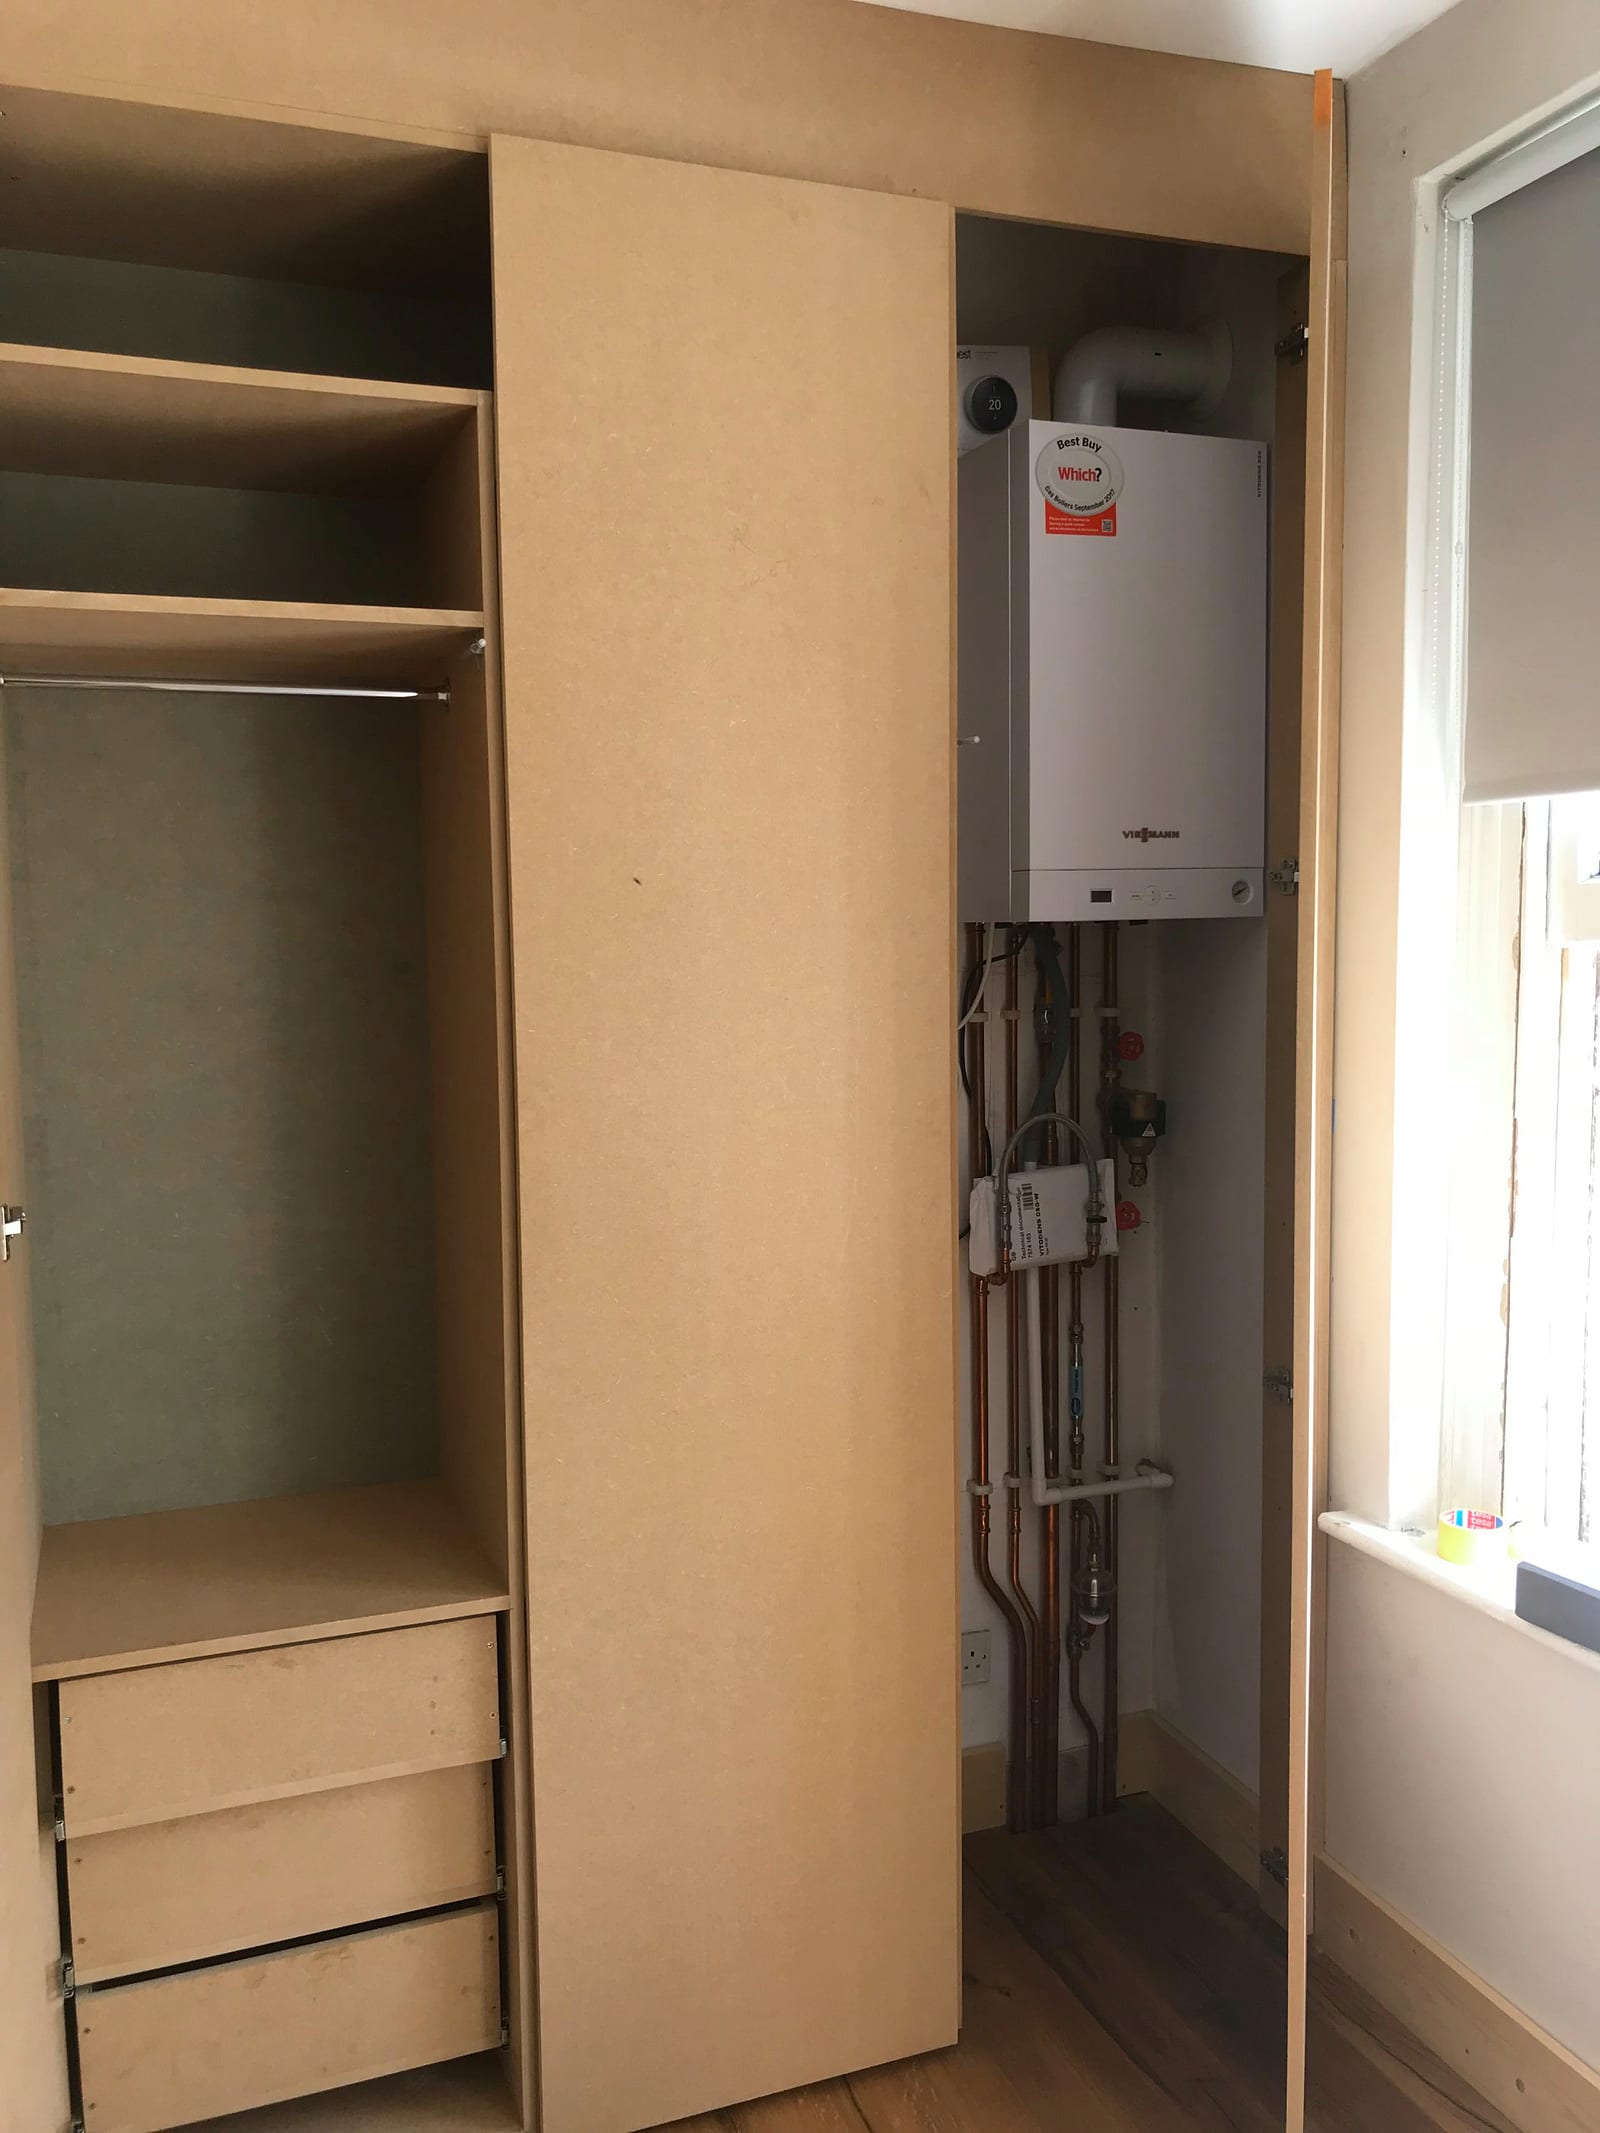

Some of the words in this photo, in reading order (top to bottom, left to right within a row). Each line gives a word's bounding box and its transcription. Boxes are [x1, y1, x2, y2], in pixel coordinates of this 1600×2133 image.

[988, 399, 1002, 411] 20
[1056, 436, 1081, 450] Best
[1081, 437, 1102, 453] Buy
[1058, 466, 1103, 482] Which?
[1044, 485, 1054, 498] Gas
[1053, 495, 1074, 510] Boilers
[1074, 501, 1105, 512] September
[1019, 1231, 1027, 1260] Technical
[1036, 1218, 1045, 1257] VITODENS
